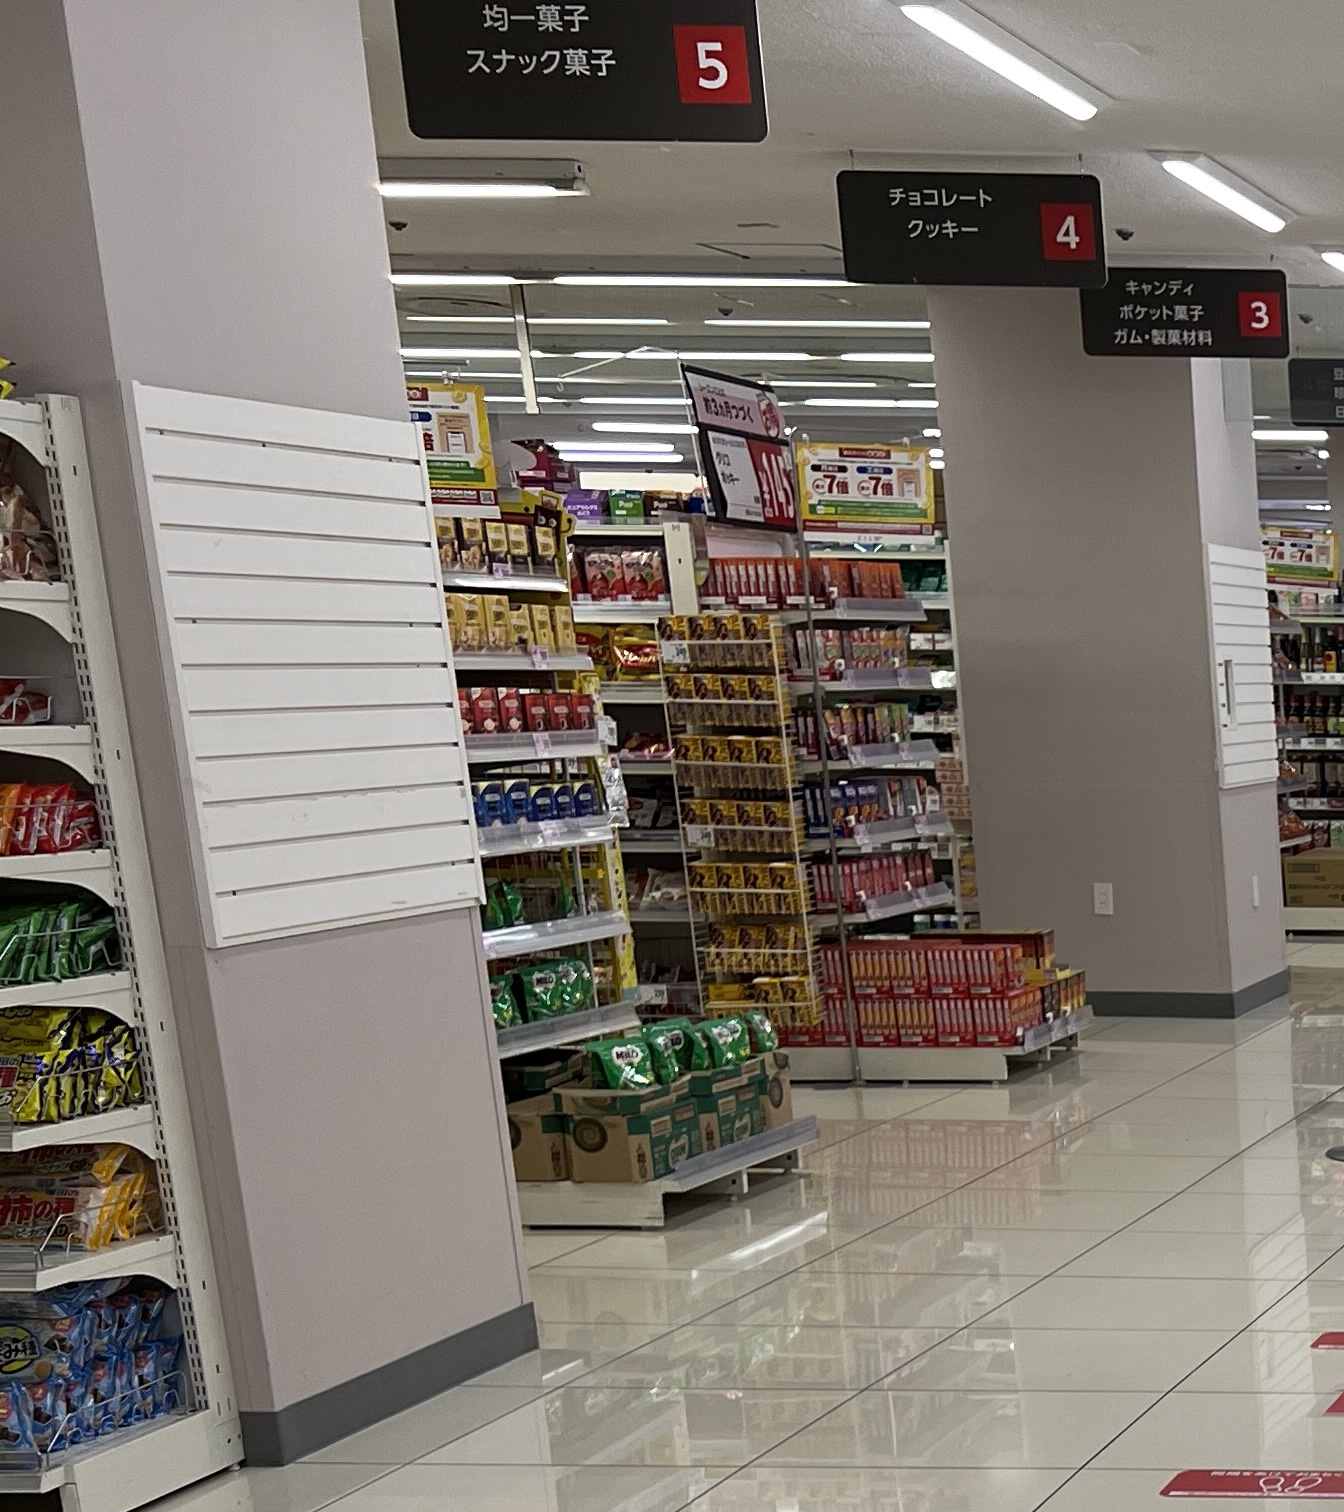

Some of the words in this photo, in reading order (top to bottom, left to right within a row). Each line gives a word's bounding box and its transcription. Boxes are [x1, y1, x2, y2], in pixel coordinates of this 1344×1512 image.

[482, 4, 590, 33] 均一菓子
[466, 48, 617, 77] スナック菓子
[695, 41, 729, 90] 5
[888, 187, 993, 209] チョコレート
[907, 219, 979, 239] クッキー
[1055, 215, 1080, 250] 4
[1124, 279, 1195, 297] キャンディ
[1118, 304, 1205, 322] ポケット菓子
[1250, 300, 1270, 330] 3
[1113, 328, 1213, 347] ガム・製菓材料
[614, 1050, 640, 1061] MILO
